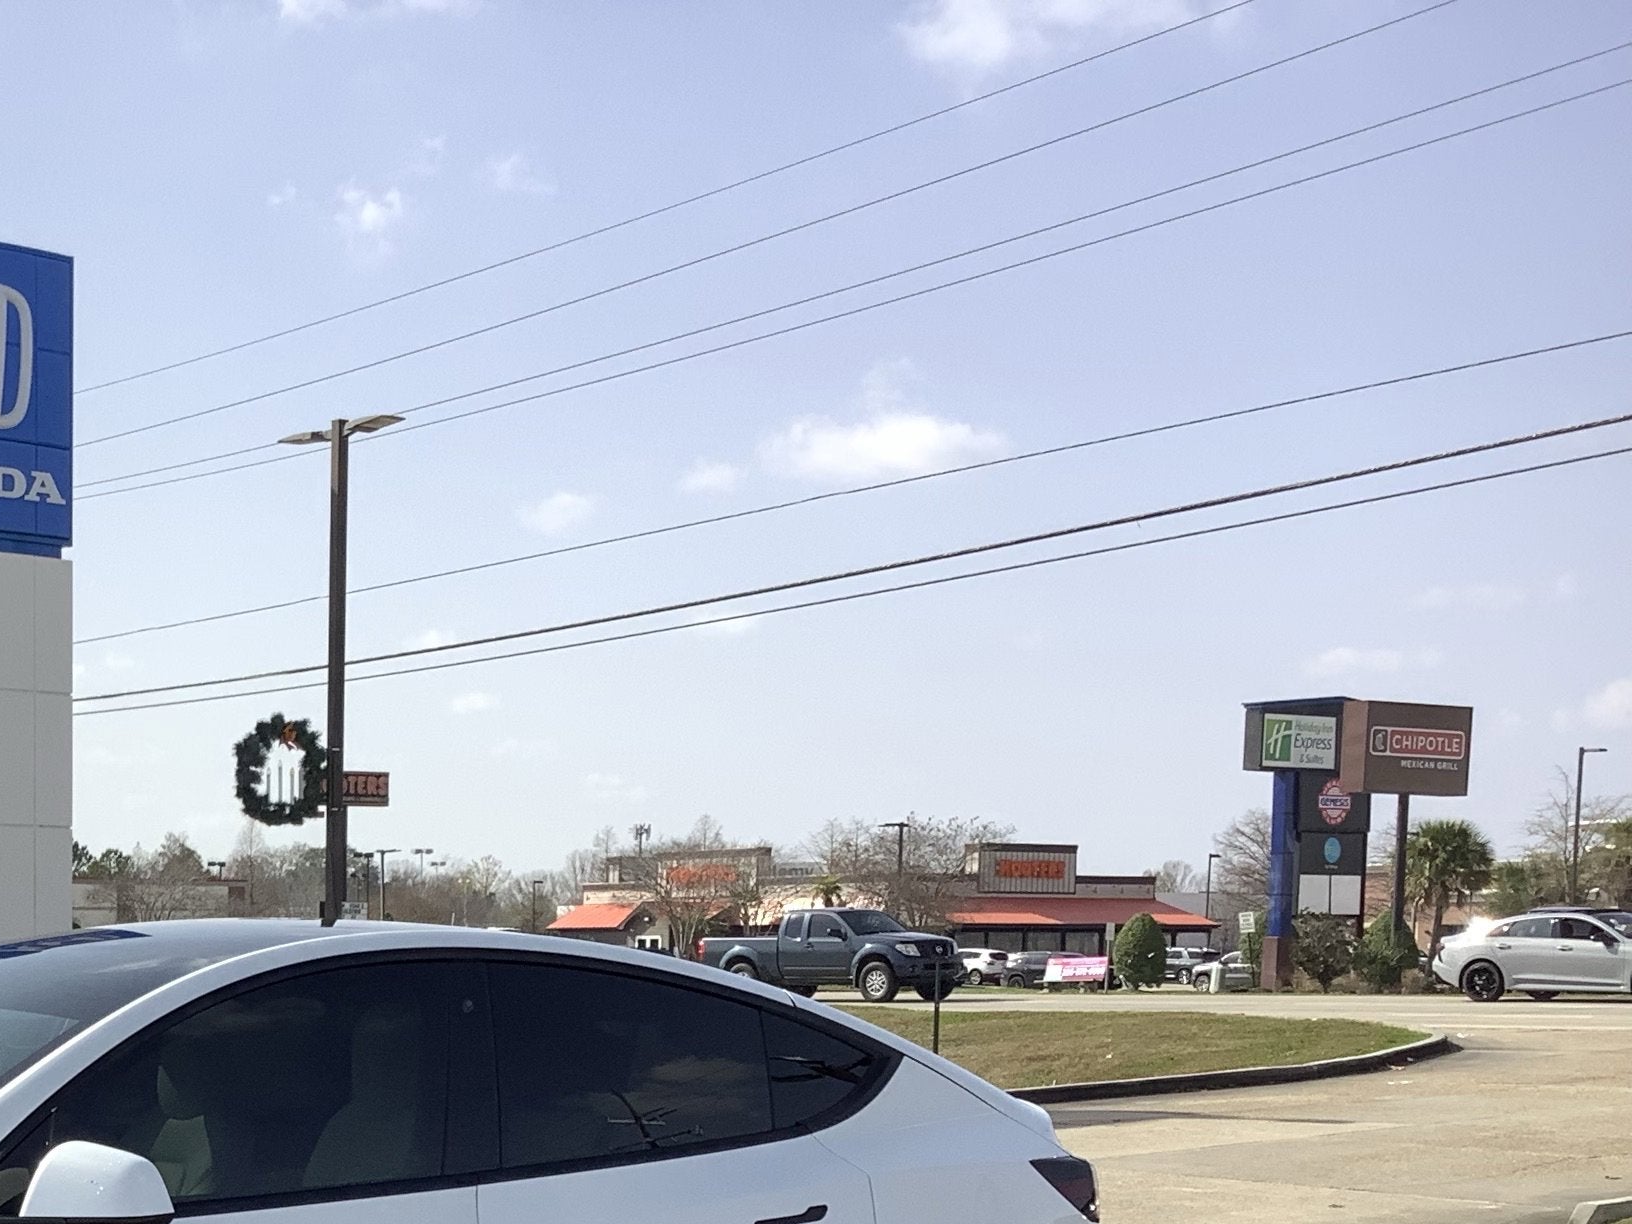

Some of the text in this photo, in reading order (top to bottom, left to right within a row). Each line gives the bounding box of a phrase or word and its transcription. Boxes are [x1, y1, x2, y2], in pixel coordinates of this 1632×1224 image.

[1295, 719, 1334, 735] Holiday Inn
[1293, 732, 1332, 752] Express
[1392, 734, 1461, 753] CHIPOTLE
[1305, 753, 1324, 765] Suites
[1401, 760, 1459, 771] MEXICAN GRILL
